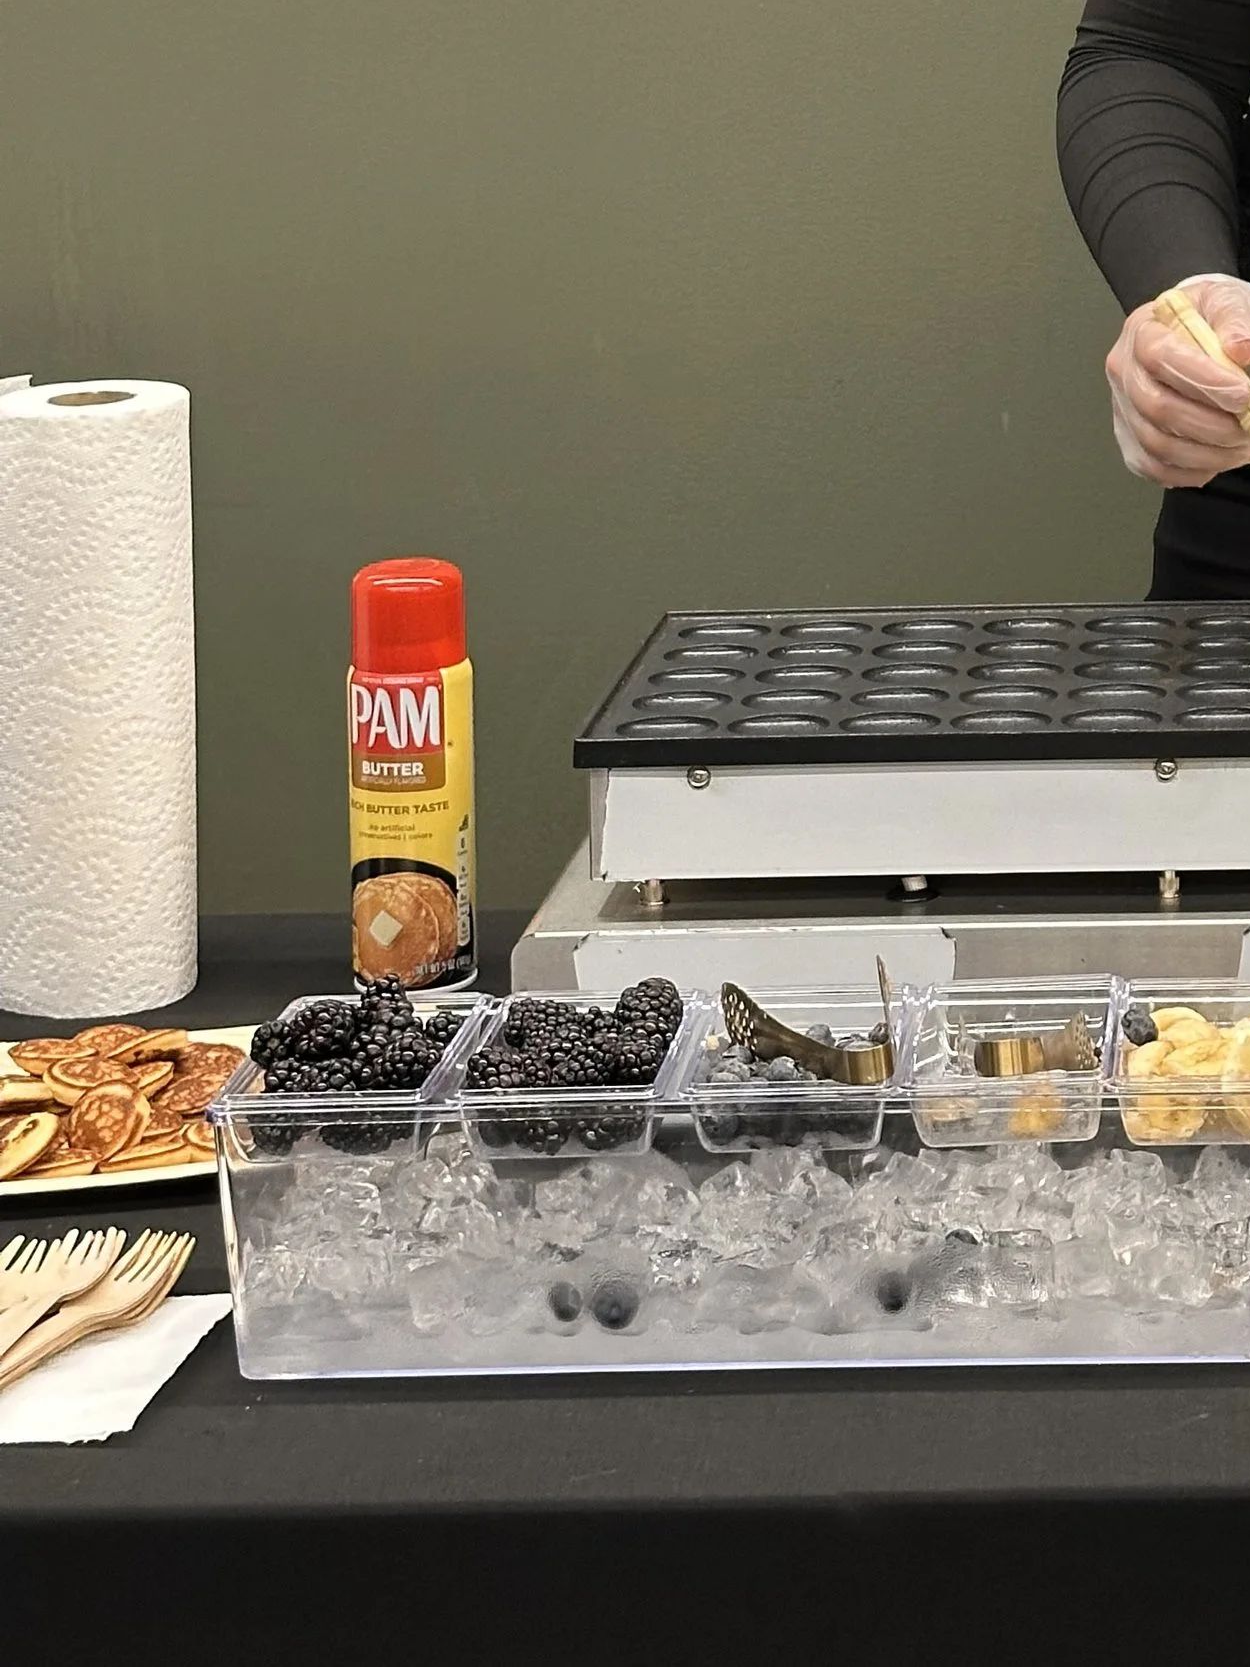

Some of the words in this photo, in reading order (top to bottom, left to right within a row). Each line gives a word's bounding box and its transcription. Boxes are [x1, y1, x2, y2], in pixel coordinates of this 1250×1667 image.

[351, 683, 441, 749] PAM
[362, 761, 424, 775] BUTTER
[366, 803, 410, 815] BUTTER
[412, 800, 450, 814] TASTE
